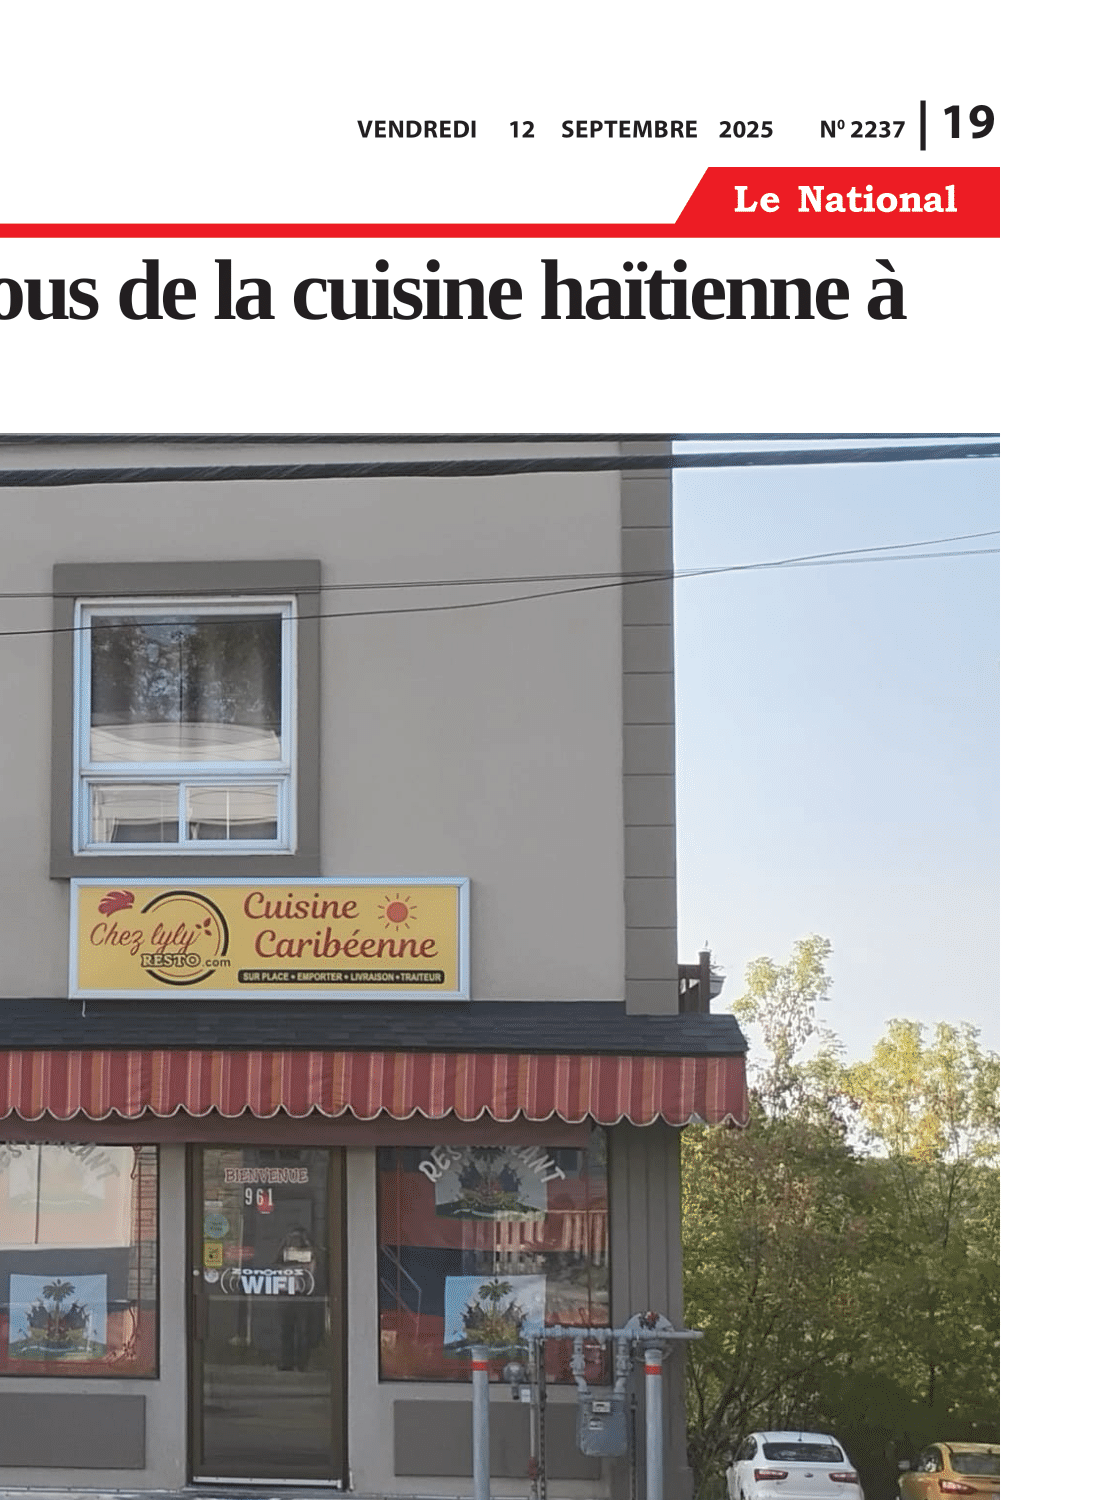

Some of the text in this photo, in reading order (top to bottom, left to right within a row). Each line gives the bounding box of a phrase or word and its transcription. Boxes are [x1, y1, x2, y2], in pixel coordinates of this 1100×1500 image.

[357, 120, 773, 138] VENDREDI 12 SEPTEMBRE 2025
[851, 120, 905, 138] 2237
[944, 105, 994, 138] 19
[735, 185, 957, 212] Le National
[120, 259, 196, 320] de
[215, 259, 275, 320] la
[294, 259, 522, 320] cuisine
[541, 259, 849, 320] haïtienne
[868, 259, 907, 320] à
[243, 891, 360, 920] Cuisine
[90, 921, 145, 957] Chez
[254, 926, 439, 958] Caribéenne
[243, 971, 442, 981] SUR PLACE EMPORTER LIVRAISON TRAITEUR
[224, 1167, 309, 1184] BIENVENUE
[245, 1187, 273, 1206] 961
[241, 1275, 296, 1296] WIFI
